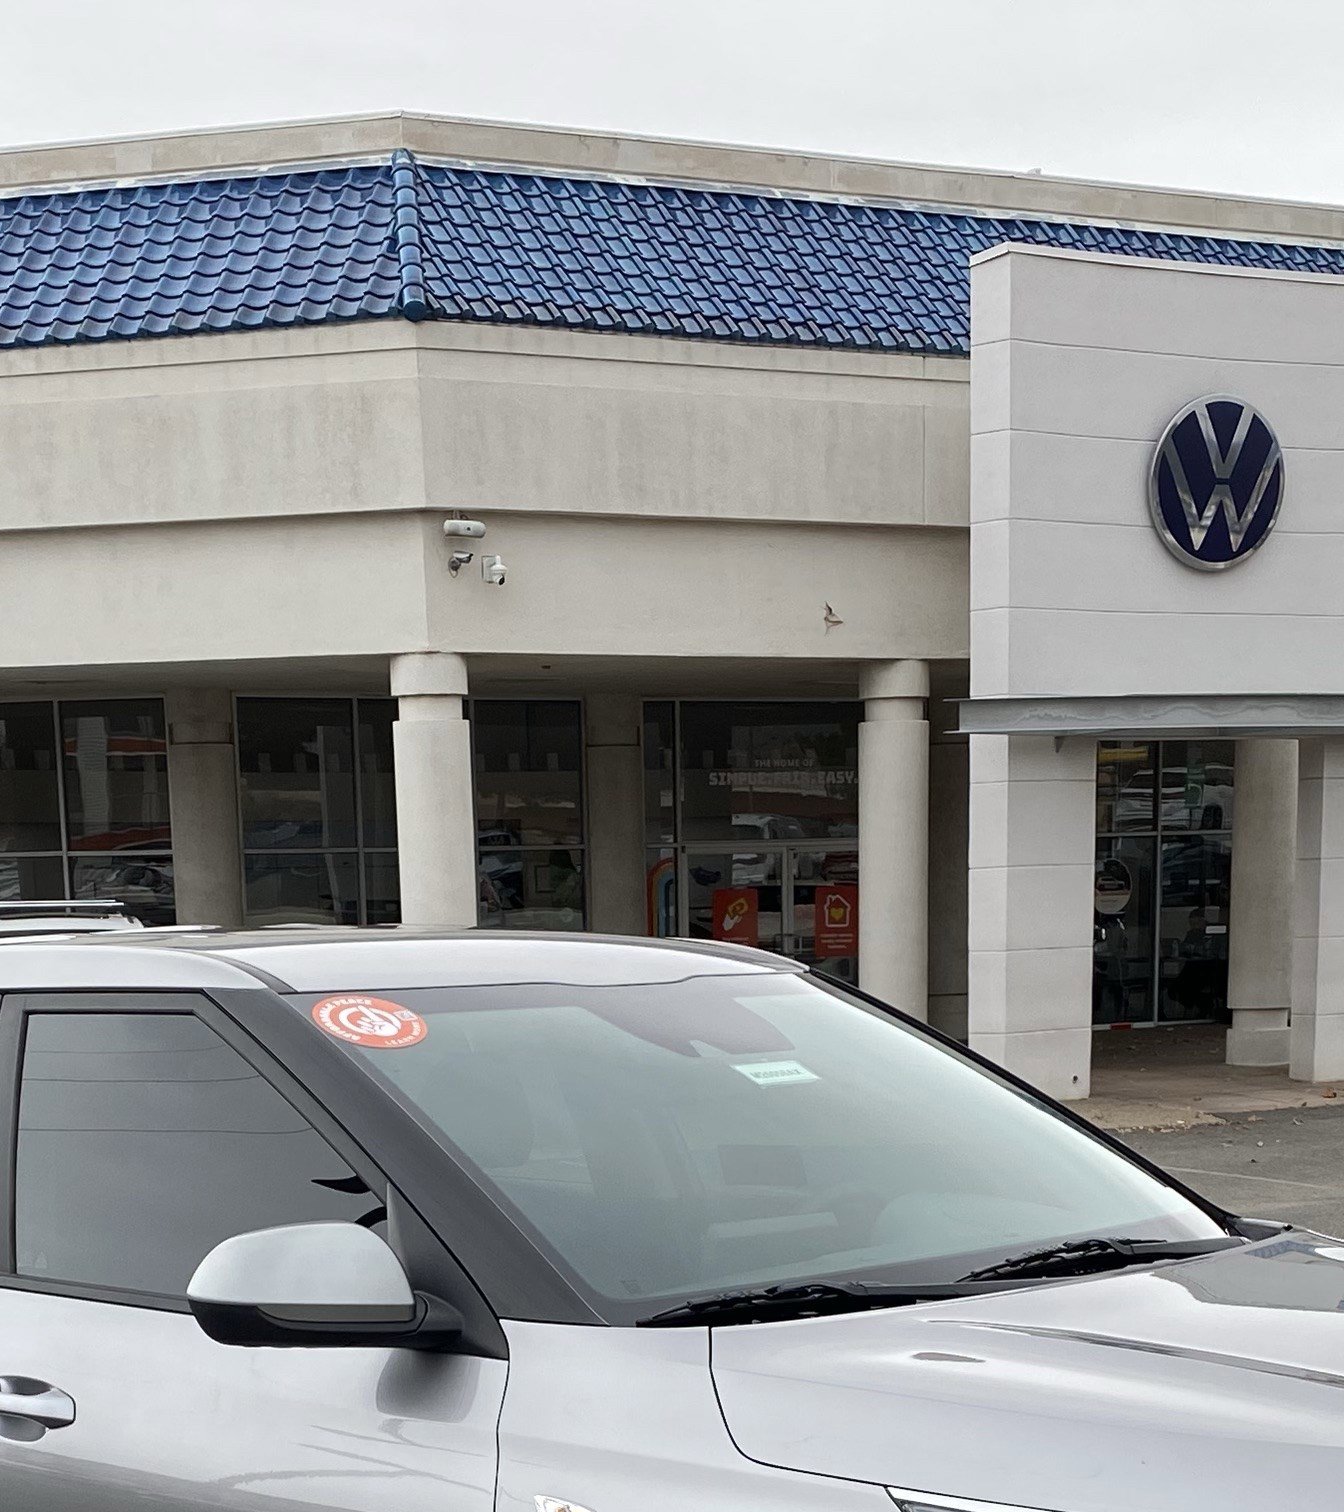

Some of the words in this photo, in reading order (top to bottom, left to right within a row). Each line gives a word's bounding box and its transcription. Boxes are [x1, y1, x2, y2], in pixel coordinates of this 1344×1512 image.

[1154, 394, 1283, 562] VW
[773, 759, 800, 767] HOME
[802, 759, 815, 767] OF
